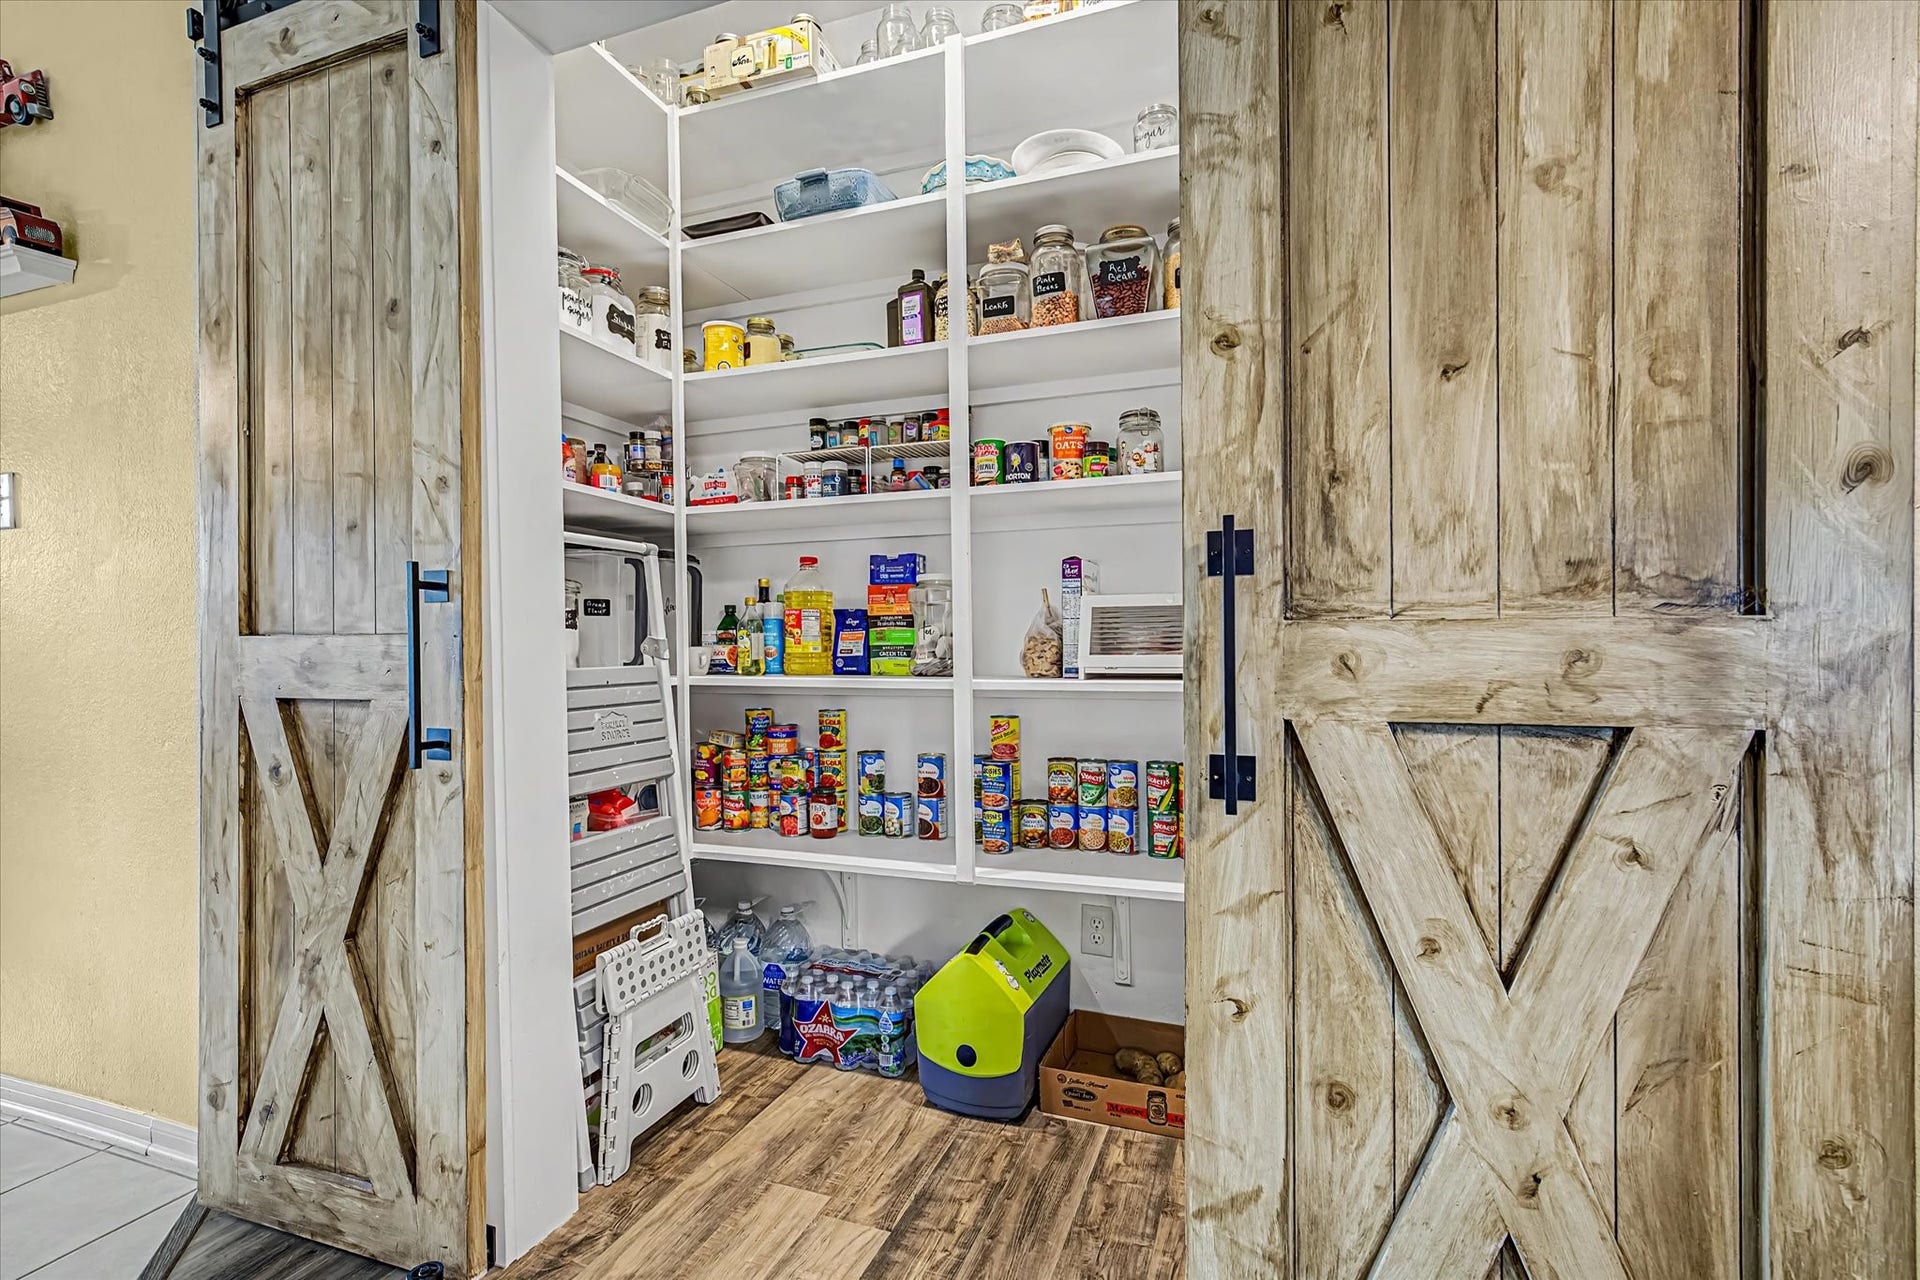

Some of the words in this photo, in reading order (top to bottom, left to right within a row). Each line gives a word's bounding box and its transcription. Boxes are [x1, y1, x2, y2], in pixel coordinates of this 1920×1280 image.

[1109, 262, 1127, 273] Red
[1108, 270, 1138, 283] Beans
[1055, 441, 1084, 450] OATS
[1024, 953, 1052, 983] Playmate
[763, 977, 784, 986] WATE
[800, 1024, 845, 1042] OZARKA
